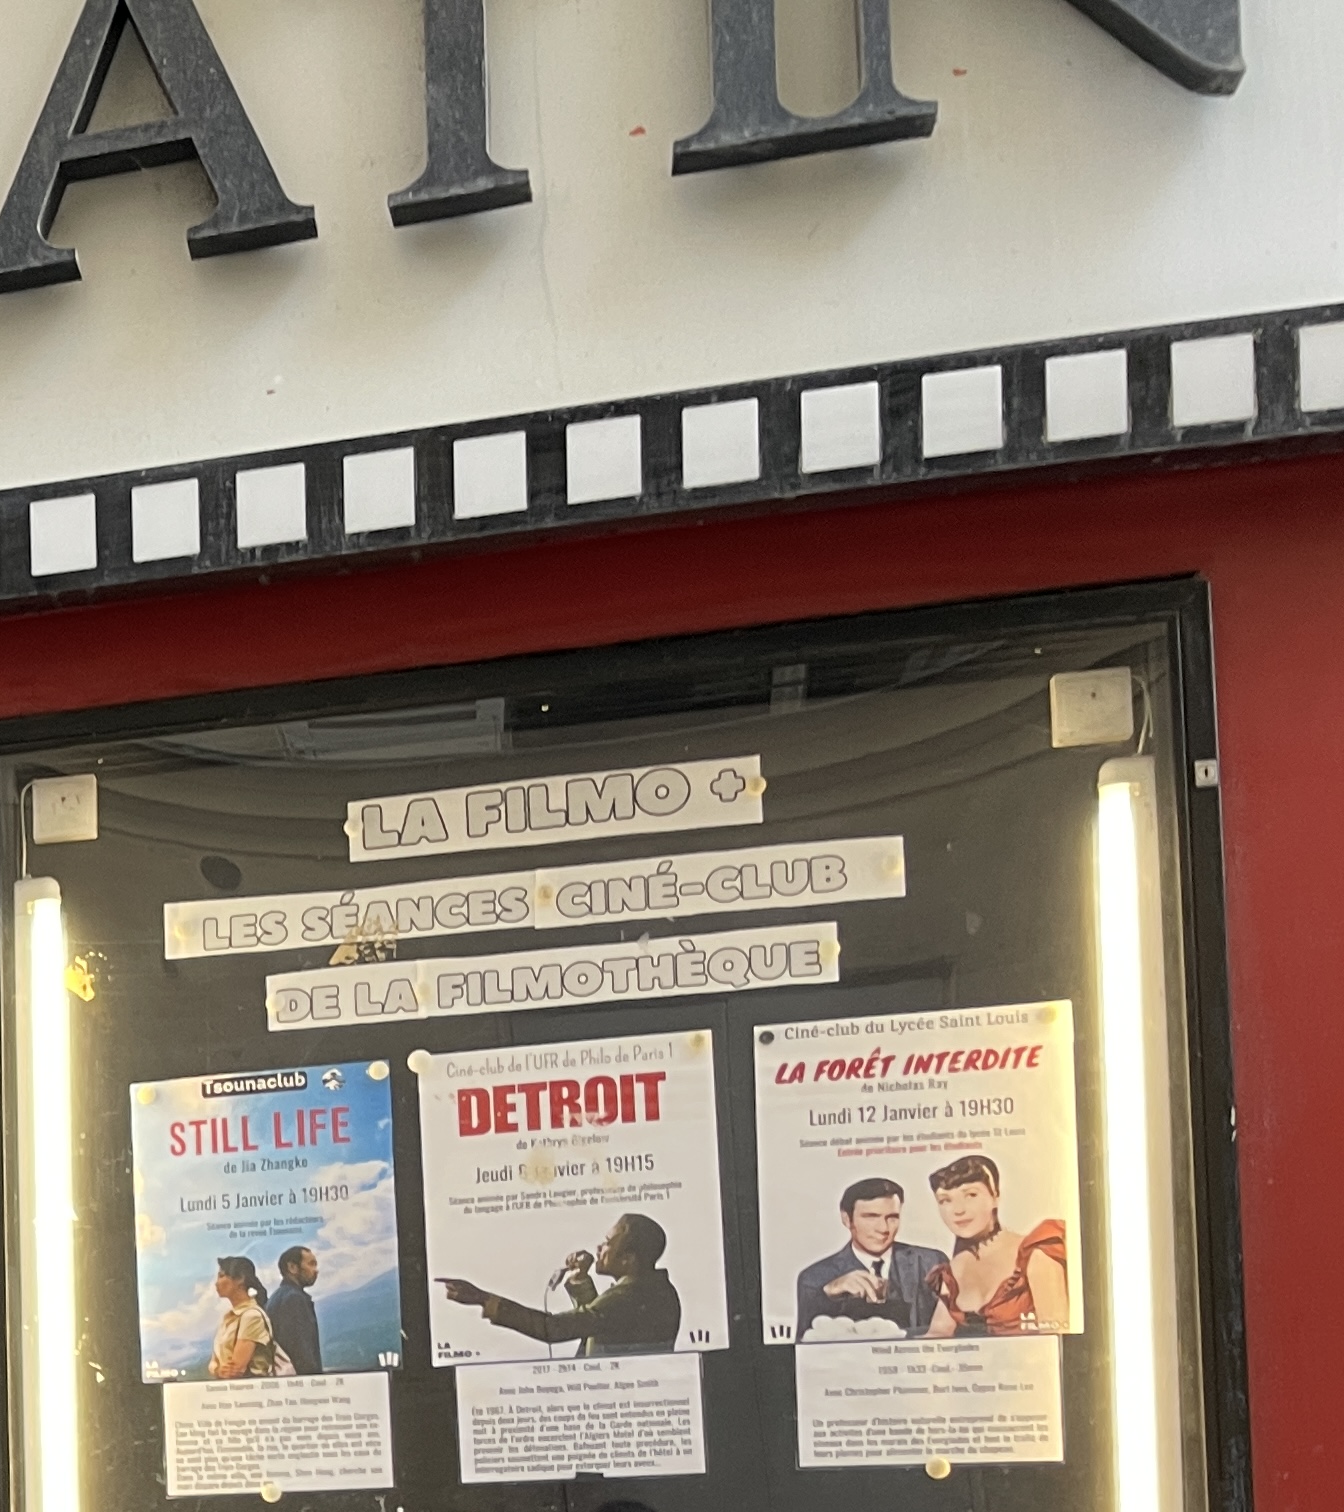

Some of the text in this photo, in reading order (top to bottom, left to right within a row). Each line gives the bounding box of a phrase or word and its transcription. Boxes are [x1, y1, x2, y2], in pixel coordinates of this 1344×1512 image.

[360, 801, 448, 850] LA
[465, 766, 692, 839] FILMO
[201, 853, 847, 950] LES SÉANCES CINÉ-CLUB
[276, 936, 822, 1025] DE LA FILMOTHÈQUE
[784, 1011, 1028, 1040] Ciné-club du Lycée Saint Louis
[508, 1057, 522, 1073] de
[562, 1051, 576, 1068] de
[581, 1048, 611, 1067] Philo
[615, 1048, 629, 1064] de
[633, 1044, 664, 1061] Paris
[774, 1045, 1043, 1084] LA FORÊT INTERDITE
[204, 1072, 306, 1095] Tsounaclub
[457, 1071, 666, 1137] DETROIT
[809, 1097, 1014, 1126] Lundi 12 Janvier à 19H30
[170, 1106, 350, 1157] STILL LIFE
[224, 1156, 308, 1174] de Jia Zhangke
[476, 1165, 512, 1184] Jeudi
[606, 1154, 654, 1174] 19H15
[180, 1185, 349, 1212] Lundi 5 Janvier à 19H30
